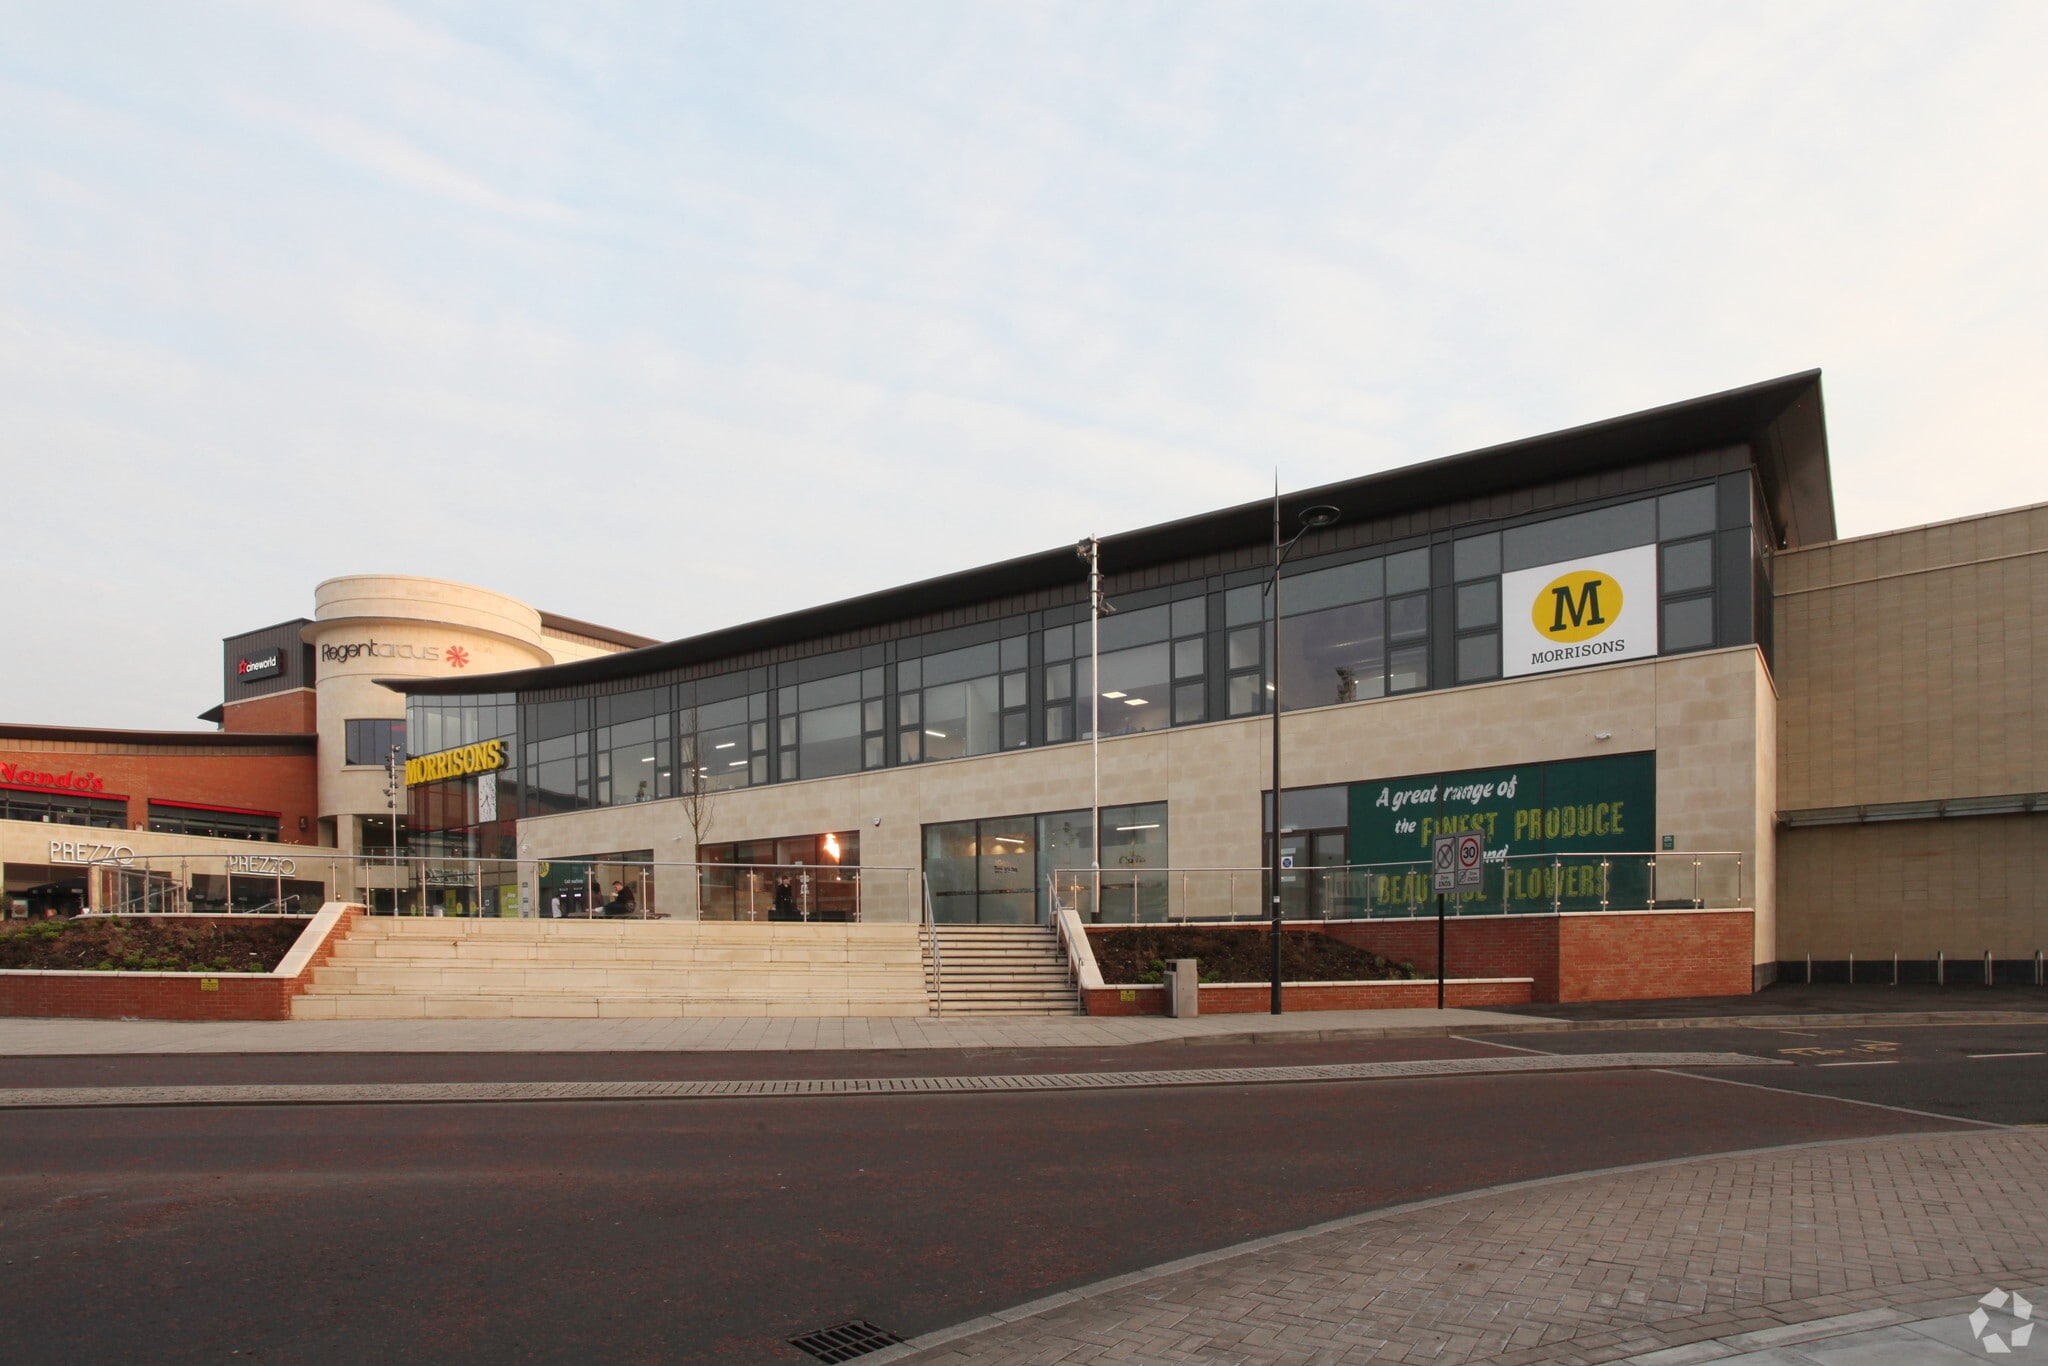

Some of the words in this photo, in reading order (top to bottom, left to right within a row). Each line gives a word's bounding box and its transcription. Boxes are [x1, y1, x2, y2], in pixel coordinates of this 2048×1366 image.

[1549, 580, 1605, 632] M
[246, 656, 276, 672] cineworld
[1531, 639, 1625, 664] MORRISONS
[0, 762, 104, 791] Nando's
[404, 740, 501, 786] MORRISONS
[1376, 787, 1389, 807] A
[1392, 784, 1438, 811] great
[1443, 782, 1494, 804] range
[1497, 774, 1517, 798] of
[1395, 818, 1417, 833] the
[1515, 801, 1624, 841] PRODUCE
[51, 840, 135, 865] PREZZO
[230, 855, 296, 875] PREZZO
[1463, 847, 1476, 858] 30
[1504, 862, 1609, 899] FLOWERS
